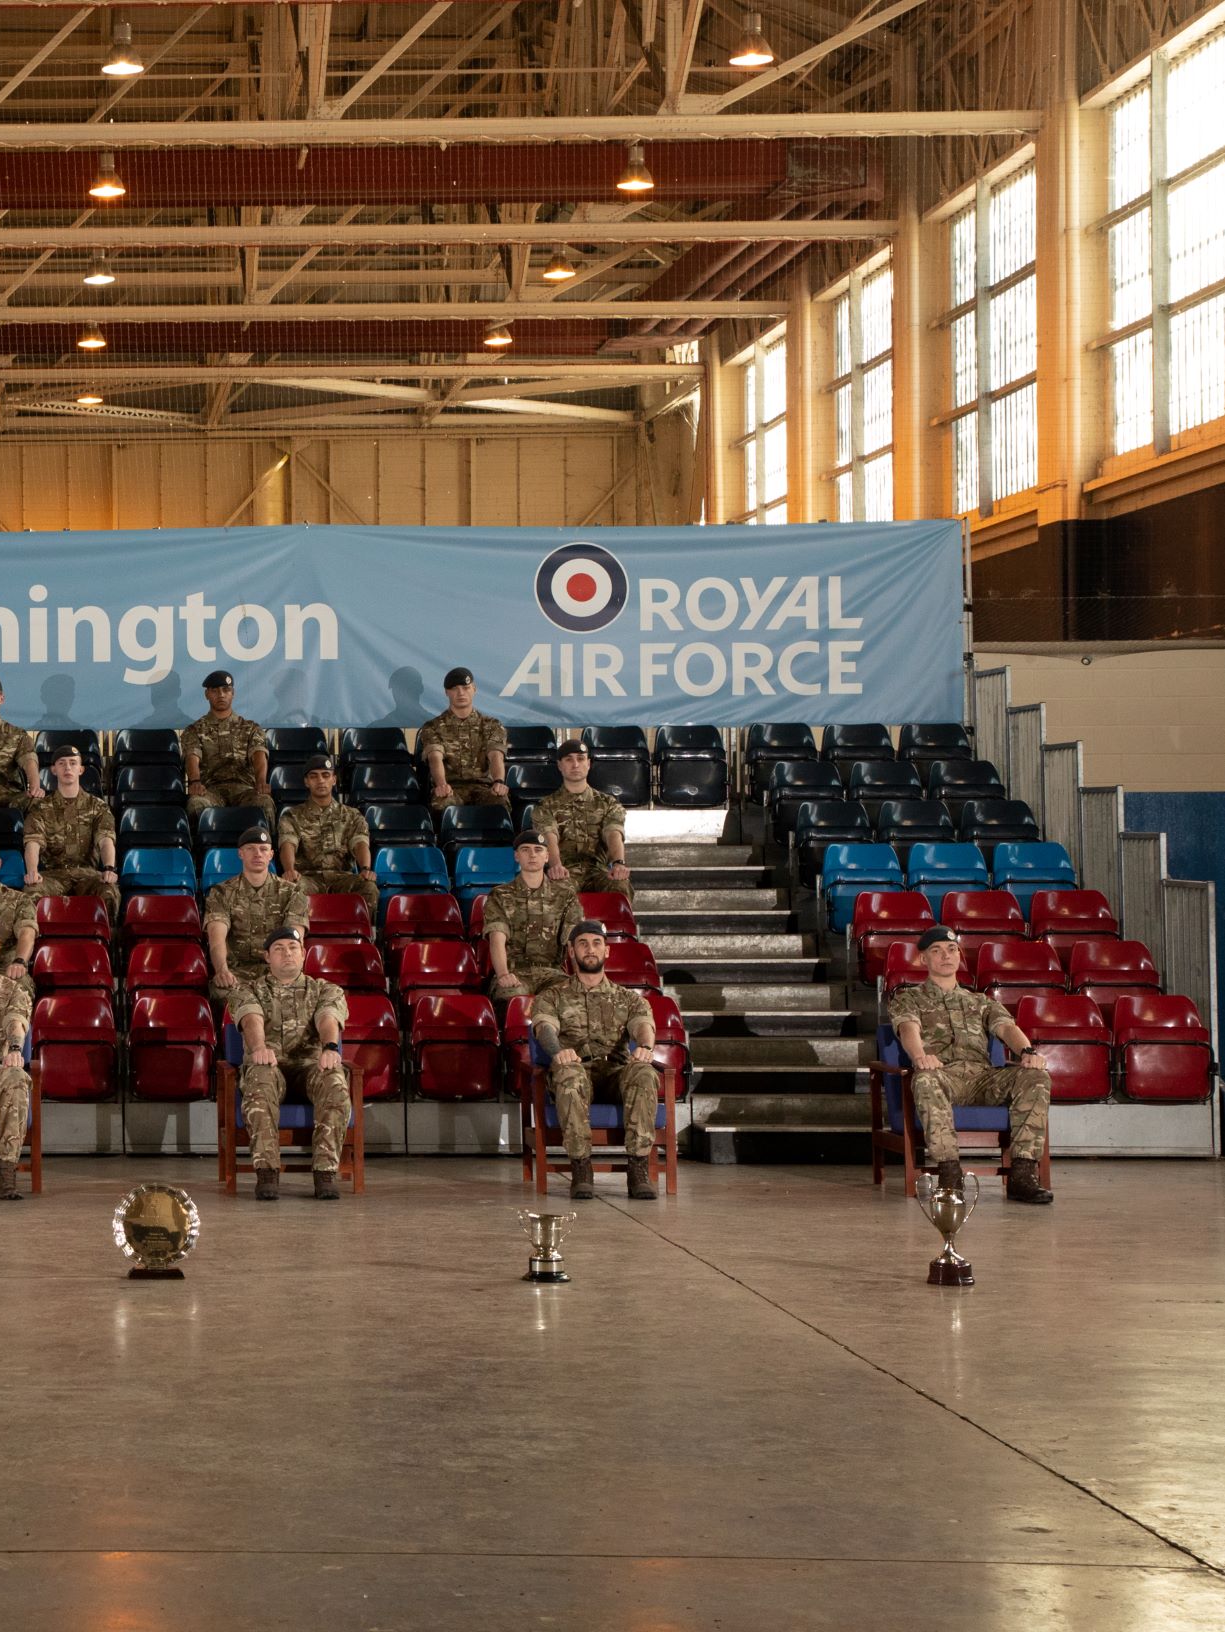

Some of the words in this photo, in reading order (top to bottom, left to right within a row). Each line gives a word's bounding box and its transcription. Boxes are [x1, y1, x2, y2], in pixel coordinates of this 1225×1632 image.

[638, 575, 865, 633] ROYAL
[498, 642, 628, 698] AIR
[638, 639, 865, 698] FORCE
